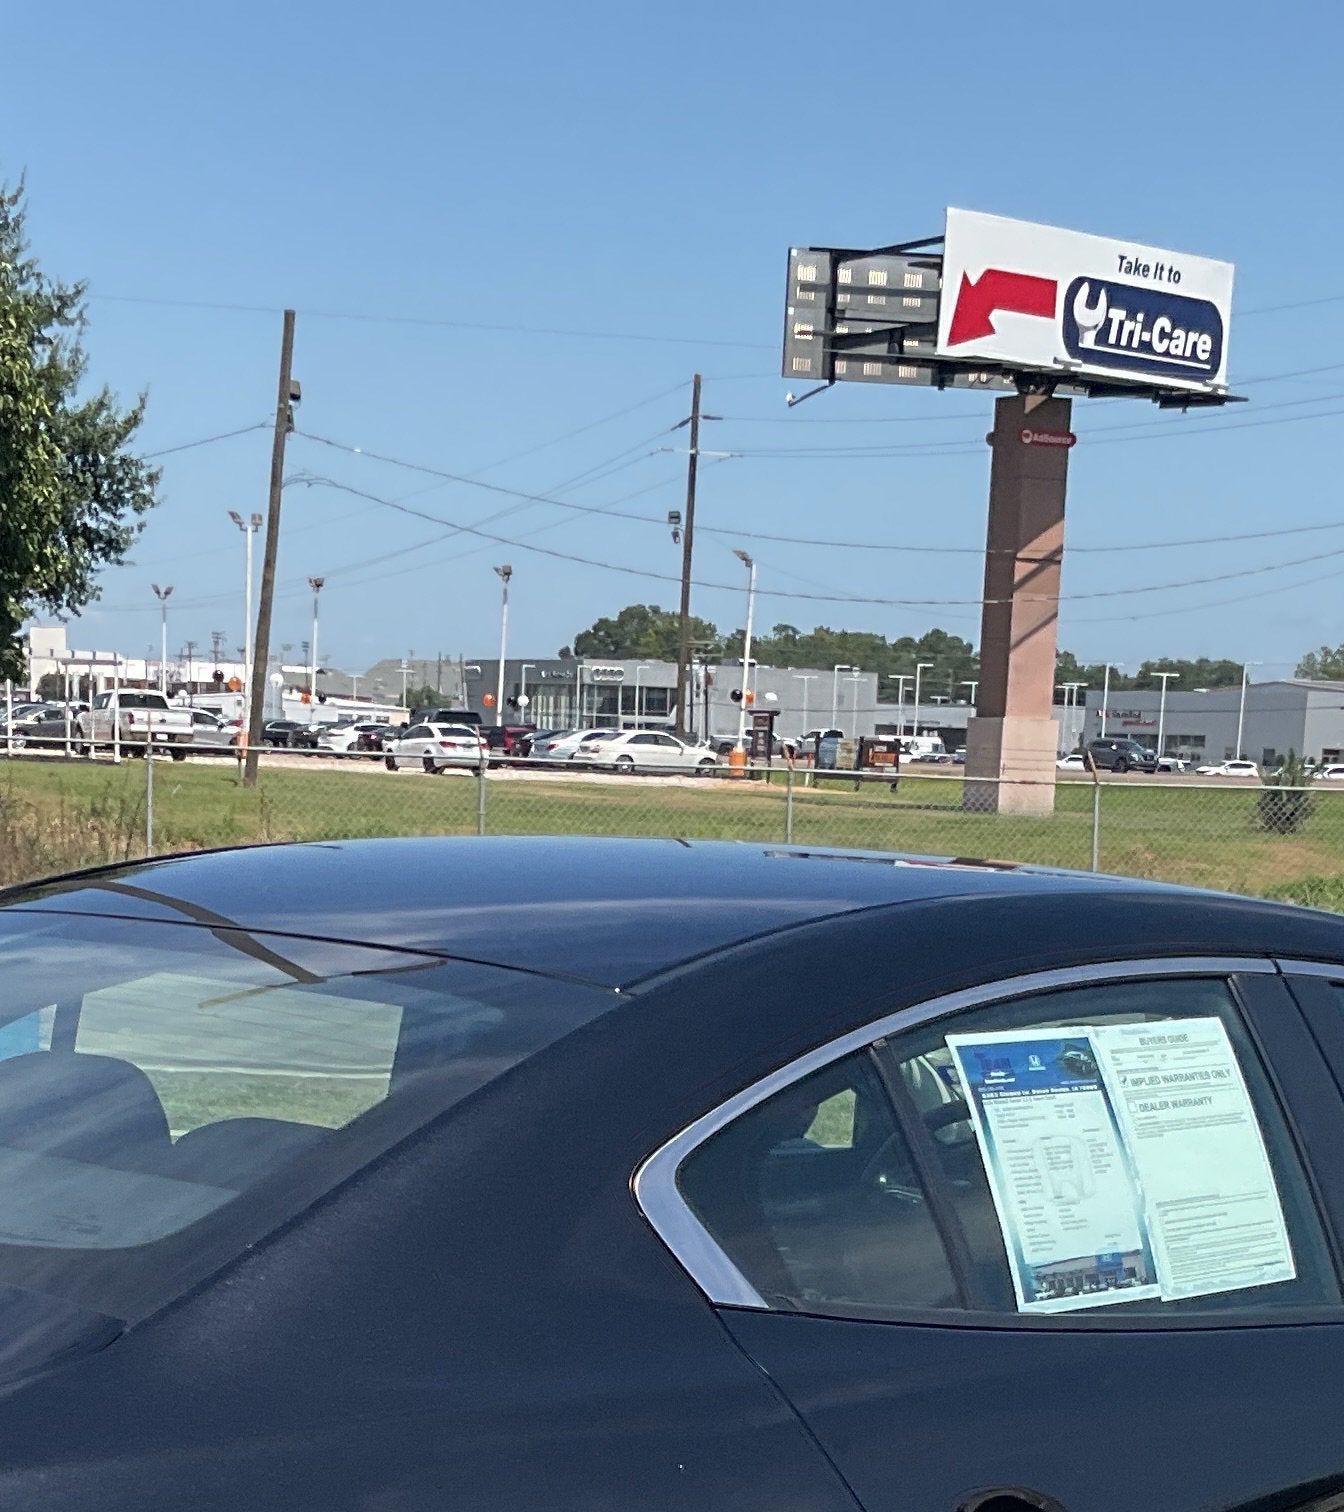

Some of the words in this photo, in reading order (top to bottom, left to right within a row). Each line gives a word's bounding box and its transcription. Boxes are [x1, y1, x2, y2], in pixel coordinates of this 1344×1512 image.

[1118, 254, 1151, 279] Take
[1153, 261, 1165, 281] It
[1167, 265, 1182, 285] to
[1107, 306, 1213, 361] Tri-Care
[1129, 1075, 1161, 1087] IMPLIED
[1161, 1070, 1211, 1085] WARRANTIES
[1211, 1068, 1232, 1079] ONLY
[1139, 1101, 1170, 1113] DEALER
[1171, 1096, 1213, 1109] WARRANTY
